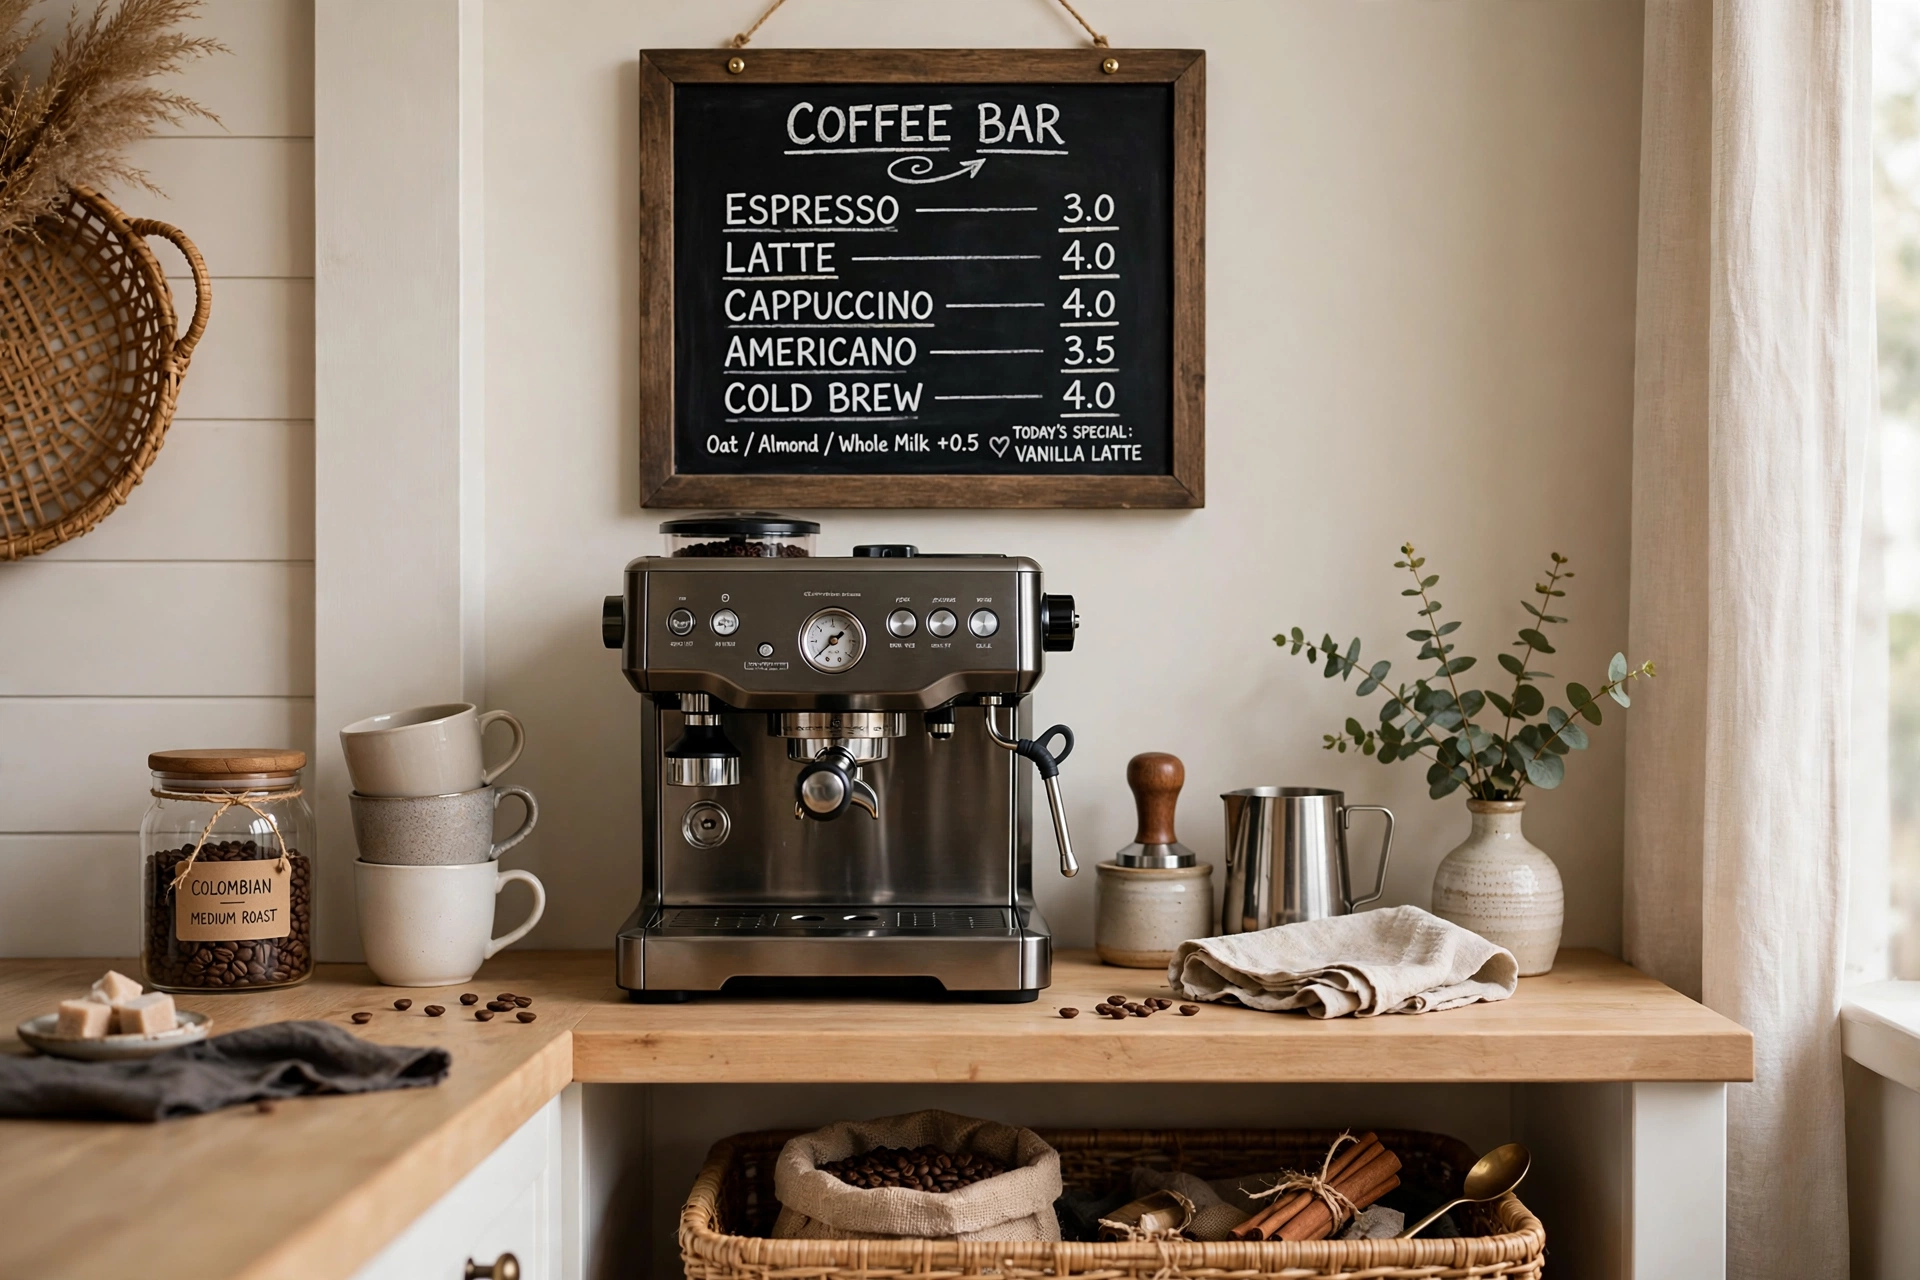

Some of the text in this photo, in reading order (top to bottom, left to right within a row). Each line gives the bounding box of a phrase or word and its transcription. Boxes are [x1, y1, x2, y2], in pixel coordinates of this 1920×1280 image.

[786, 101, 1066, 145] COFFEE BAR
[725, 192, 1116, 226] ESPRESSO 3.0
[725, 239, 1117, 274] LATTE 4.0
[724, 287, 1117, 322] CAPPUCCINO 4.0
[724, 335, 1116, 368] AMERICANO 3.5
[724, 379, 1117, 414] COLD BREW 4.0
[706, 434, 740, 454] Oat
[757, 433, 820, 454] Almond
[838, 433, 889, 454] Whole
[894, 432, 931, 453] Milk
[937, 433, 980, 453] +0.5
[1012, 424, 1134, 441] TODAY'S SPECIAL:
[1014, 444, 1143, 463] VANILLA LATTE
[191, 878, 272, 896] COLOMBIAN
[190, 908, 278, 926] MEDIUM ROAST
